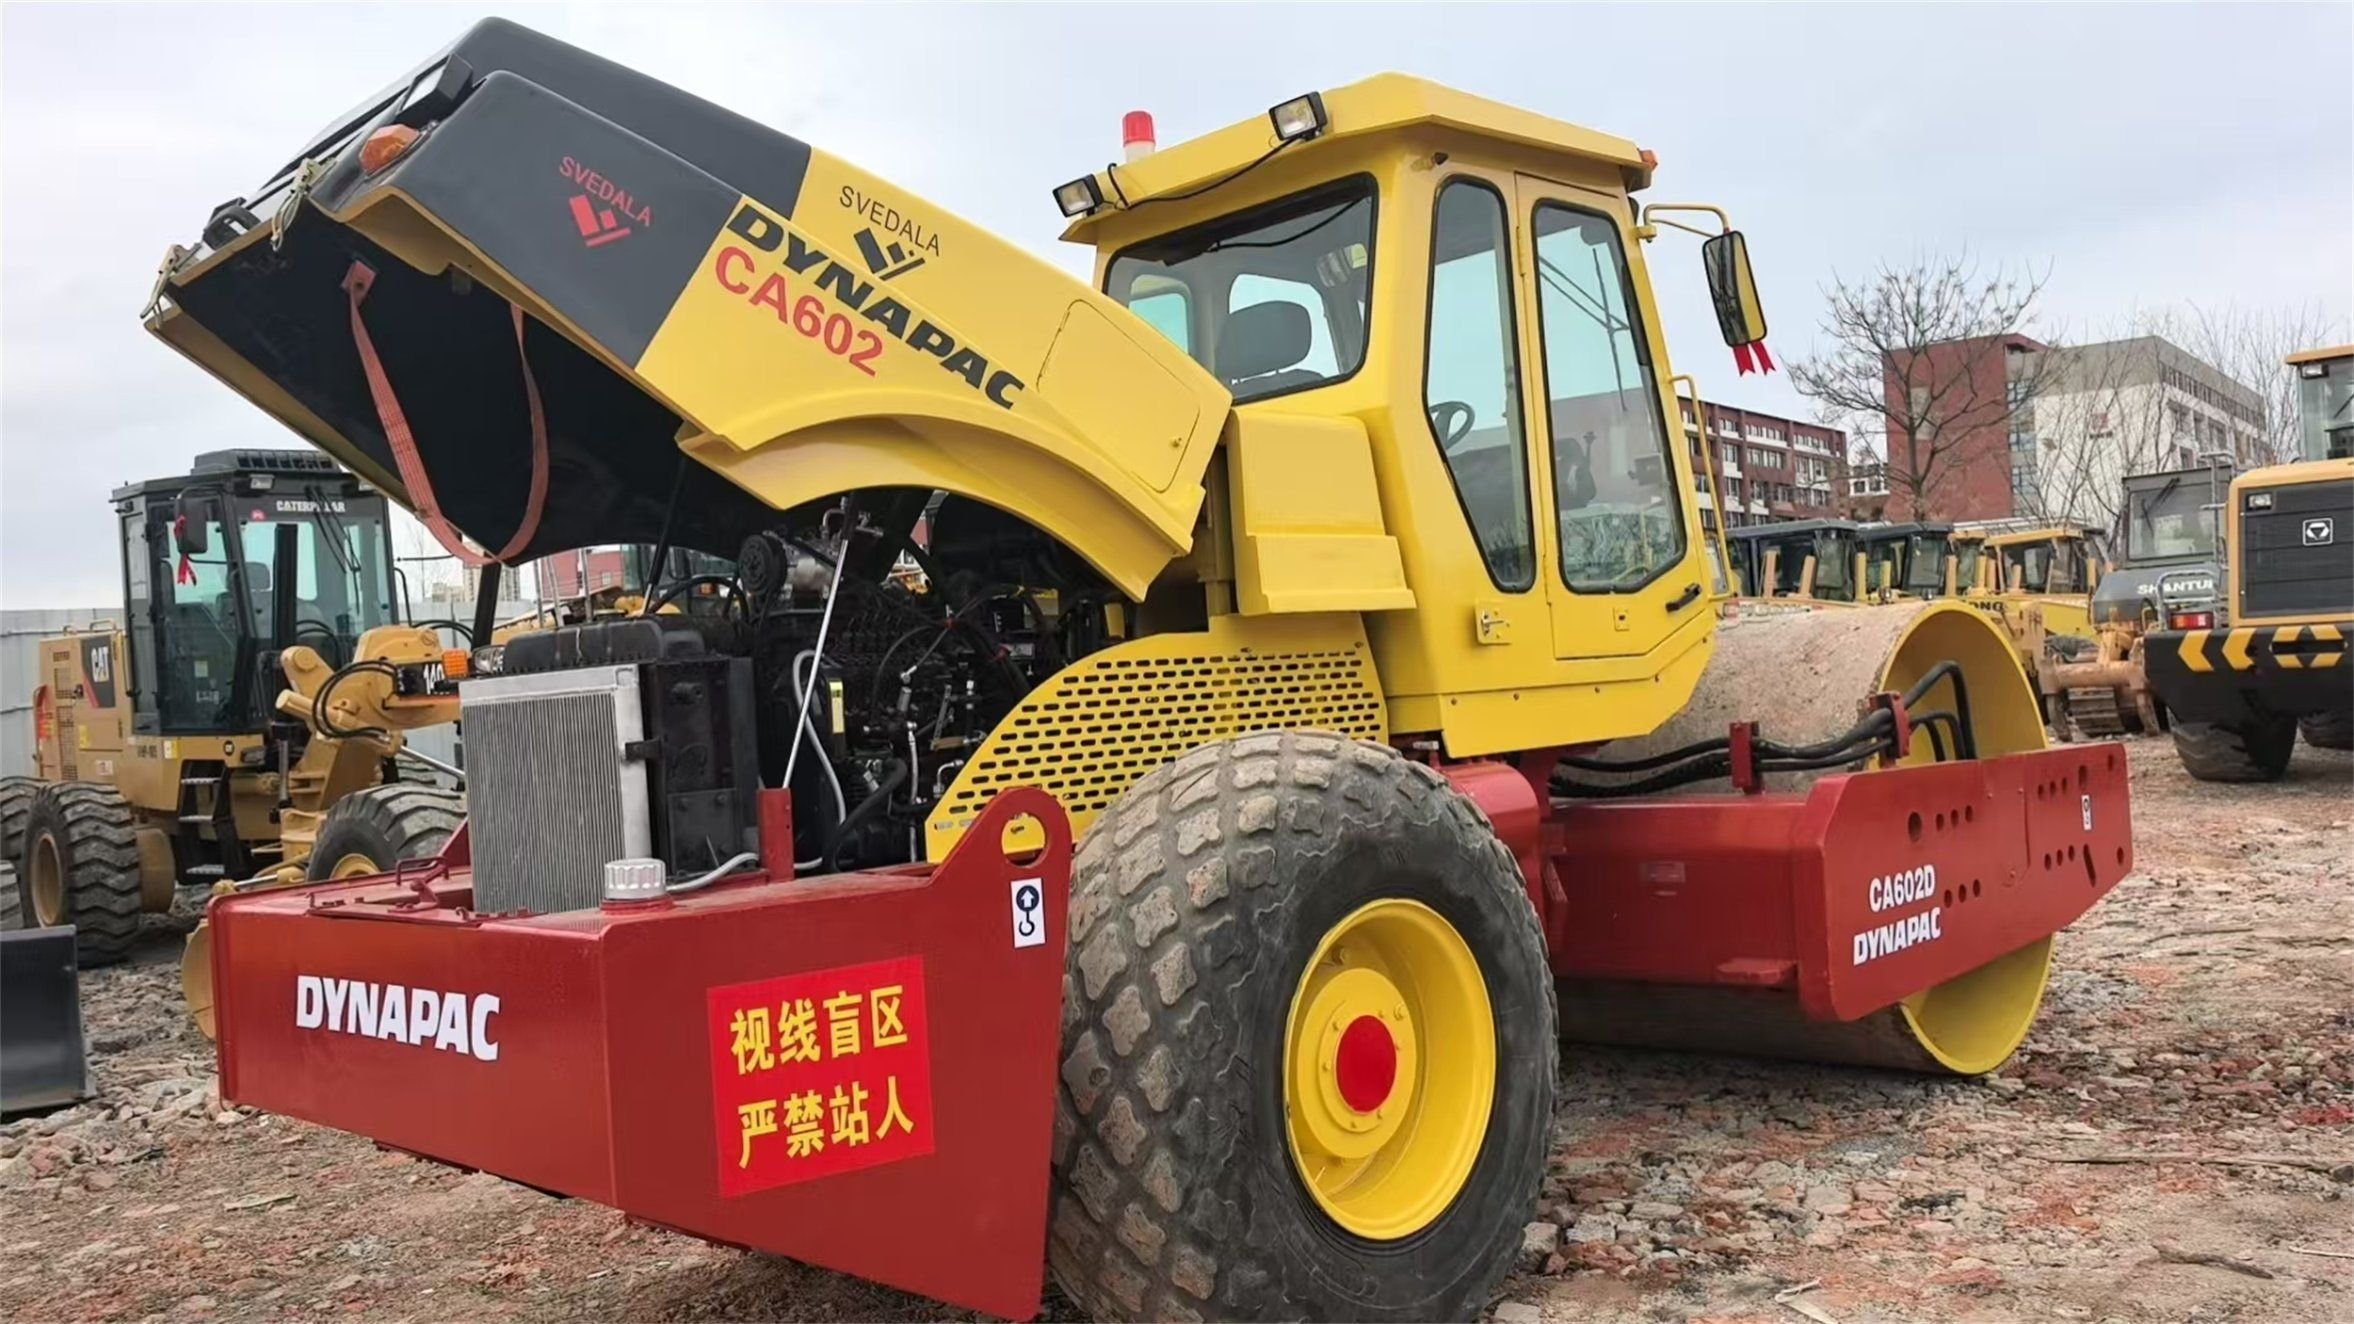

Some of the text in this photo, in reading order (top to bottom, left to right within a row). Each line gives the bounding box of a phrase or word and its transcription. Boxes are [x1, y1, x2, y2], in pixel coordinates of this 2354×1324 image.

[559, 156, 654, 228] SVEDALA
[839, 185, 940, 256] SVEDALA
[714, 245, 885, 378] CA602
[726, 203, 1025, 410] DYNAPAC
[2137, 579, 2213, 595] SHANTUI
[91, 646, 110, 683] CAT
[1869, 864, 1936, 912] CA602D
[1853, 907, 1941, 966] DYNAPAC
[296, 975, 500, 1061] DYNAPAC
[730, 985, 908, 1075] 视线盲区
[738, 1076, 914, 1169] 严禁站人
